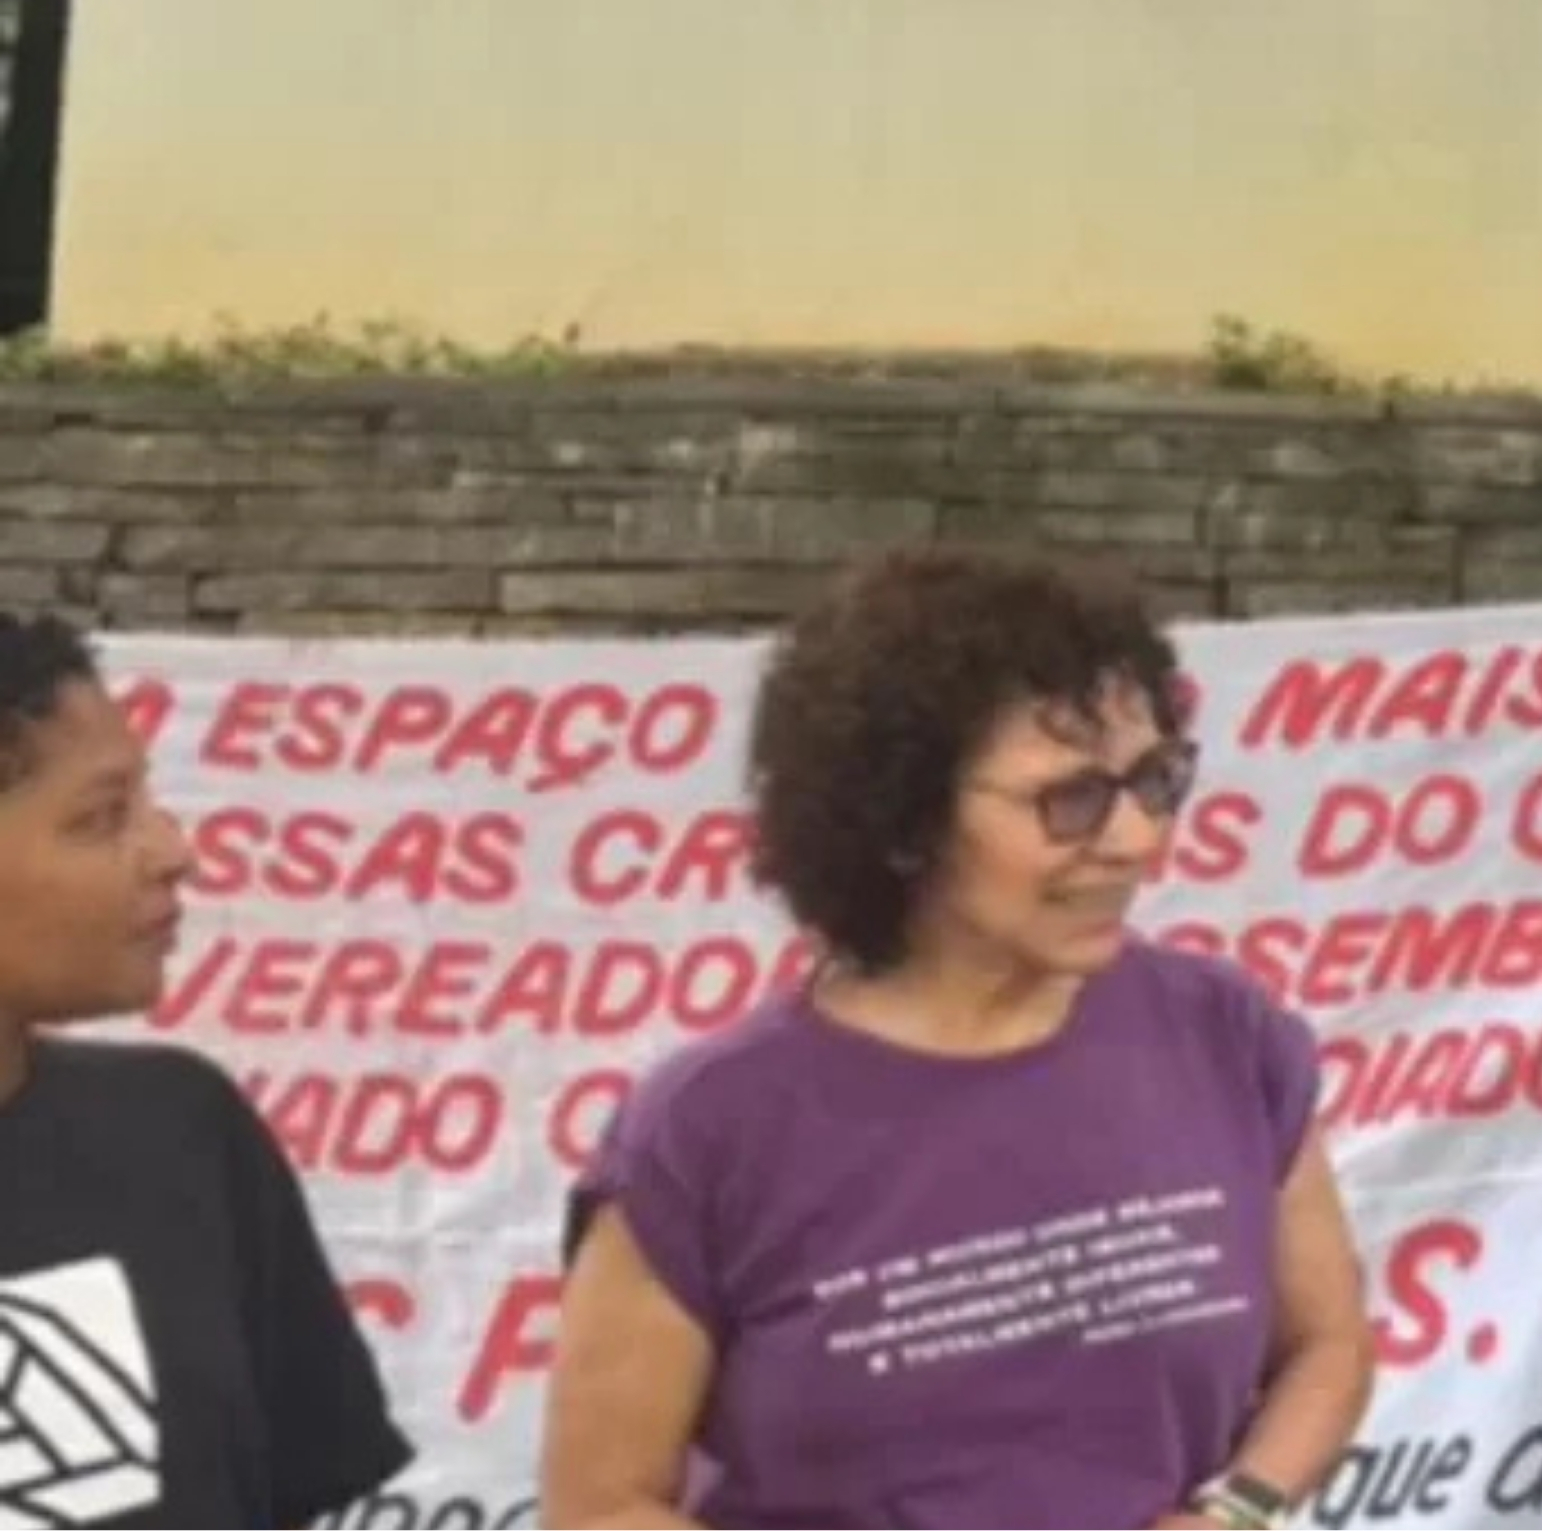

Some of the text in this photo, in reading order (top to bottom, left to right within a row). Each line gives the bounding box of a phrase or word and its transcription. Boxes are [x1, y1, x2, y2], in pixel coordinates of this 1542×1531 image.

[203, 680, 718, 794] ESPAÇO
[184, 805, 524, 902] SSAS
[1297, 773, 1481, 878] DO
